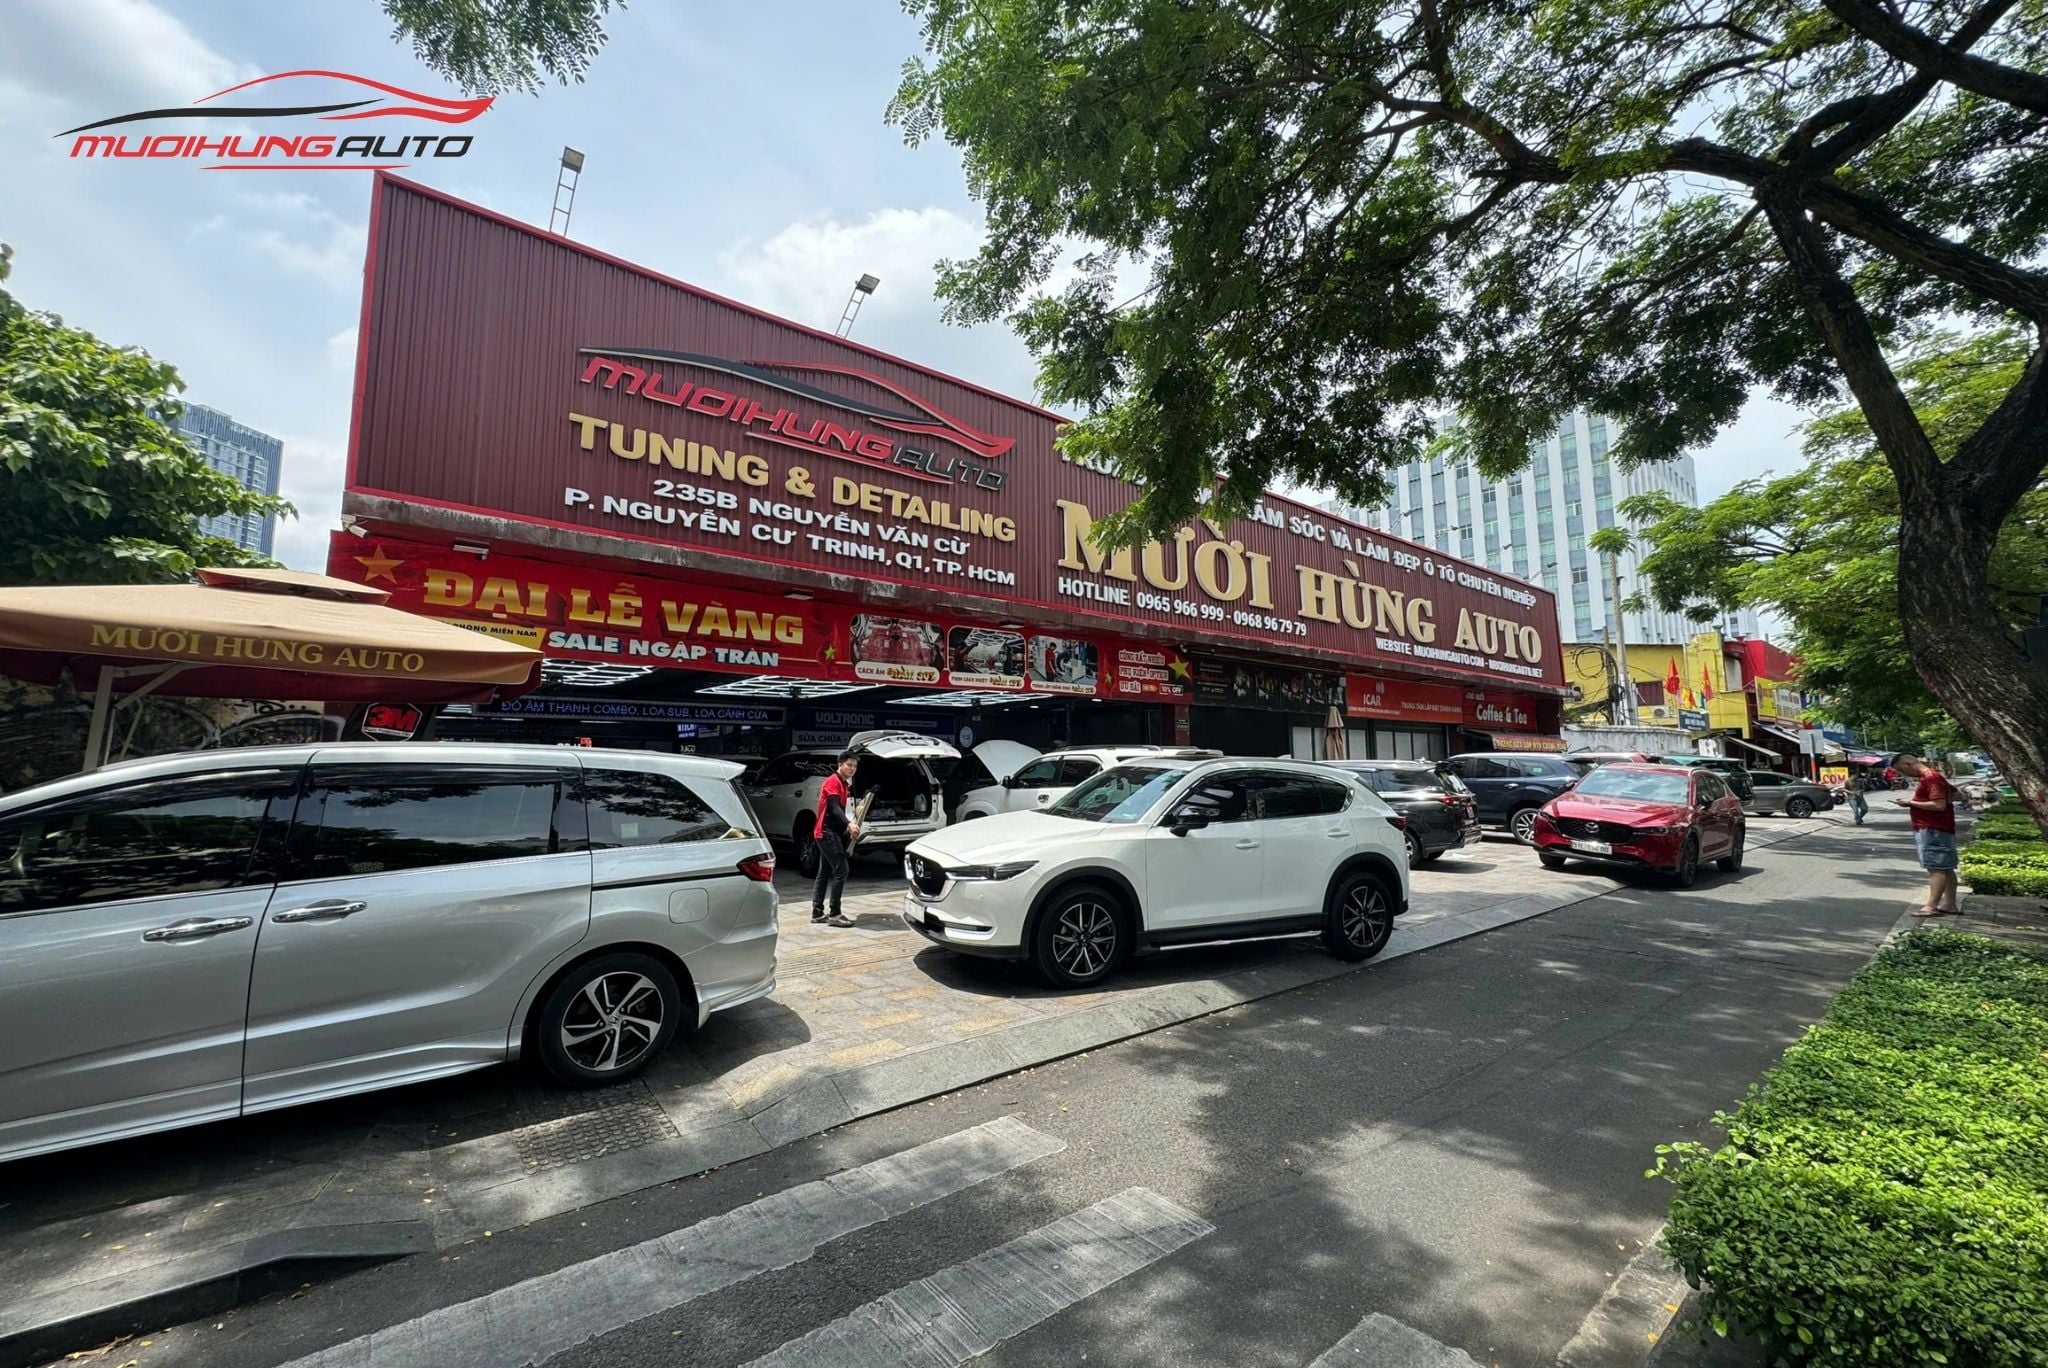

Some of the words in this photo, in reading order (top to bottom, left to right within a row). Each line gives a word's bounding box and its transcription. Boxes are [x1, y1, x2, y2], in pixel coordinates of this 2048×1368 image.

[568, 412, 769, 487] TUNING
[785, 466, 816, 498] &
[832, 476, 1016, 542] DETAILING
[564, 487, 595, 509] P.
[603, 495, 740, 536] NGUYỄN
[752, 524, 797, 545] CƯ
[653, 479, 738, 509] 235B
[749, 497, 870, 537] NGUYỄN
[877, 524, 929, 548] VĂN
[1288, 514, 1325, 542] SÓC
[1330, 527, 1352, 551] VÀ
[1355, 537, 1389, 562] LÀM
[1393, 550, 1420, 573] ĐẸP
[1423, 557, 1434, 576] Ô
[1437, 564, 1455, 582] TÔ
[1458, 572, 1501, 597] CHUYÊN
[1503, 586, 1537, 610] NGHIỆP
[1056, 499, 1274, 610] MƯỜI
[1295, 559, 1436, 643] HÙNG
[1454, 608, 1542, 664] AUTO
[423, 568, 549, 619] ĐẠI
[569, 582, 643, 628] LỄ
[661, 600, 804, 645] VÀNG
[1136, 592, 1171, 612] 0965
[1174, 599, 1197, 618] 966
[1201, 604, 1224, 622] 999
[1233, 610, 1262, 629] 0968
[333, 647, 425, 673] AUTO
[548, 631, 619, 653] SALE
[629, 638, 707, 663] NGẬP
[715, 647, 779, 667] TRÀN
[368, 705, 417, 732] 3M
[547, 702, 590, 713] THANH
[643, 706, 665, 716] LOA
[695, 708, 715, 718] LOA
[1363, 694, 1381, 706] ICAR
[1476, 704, 1503, 722] Coffee
[1513, 708, 1528, 724] Tea
